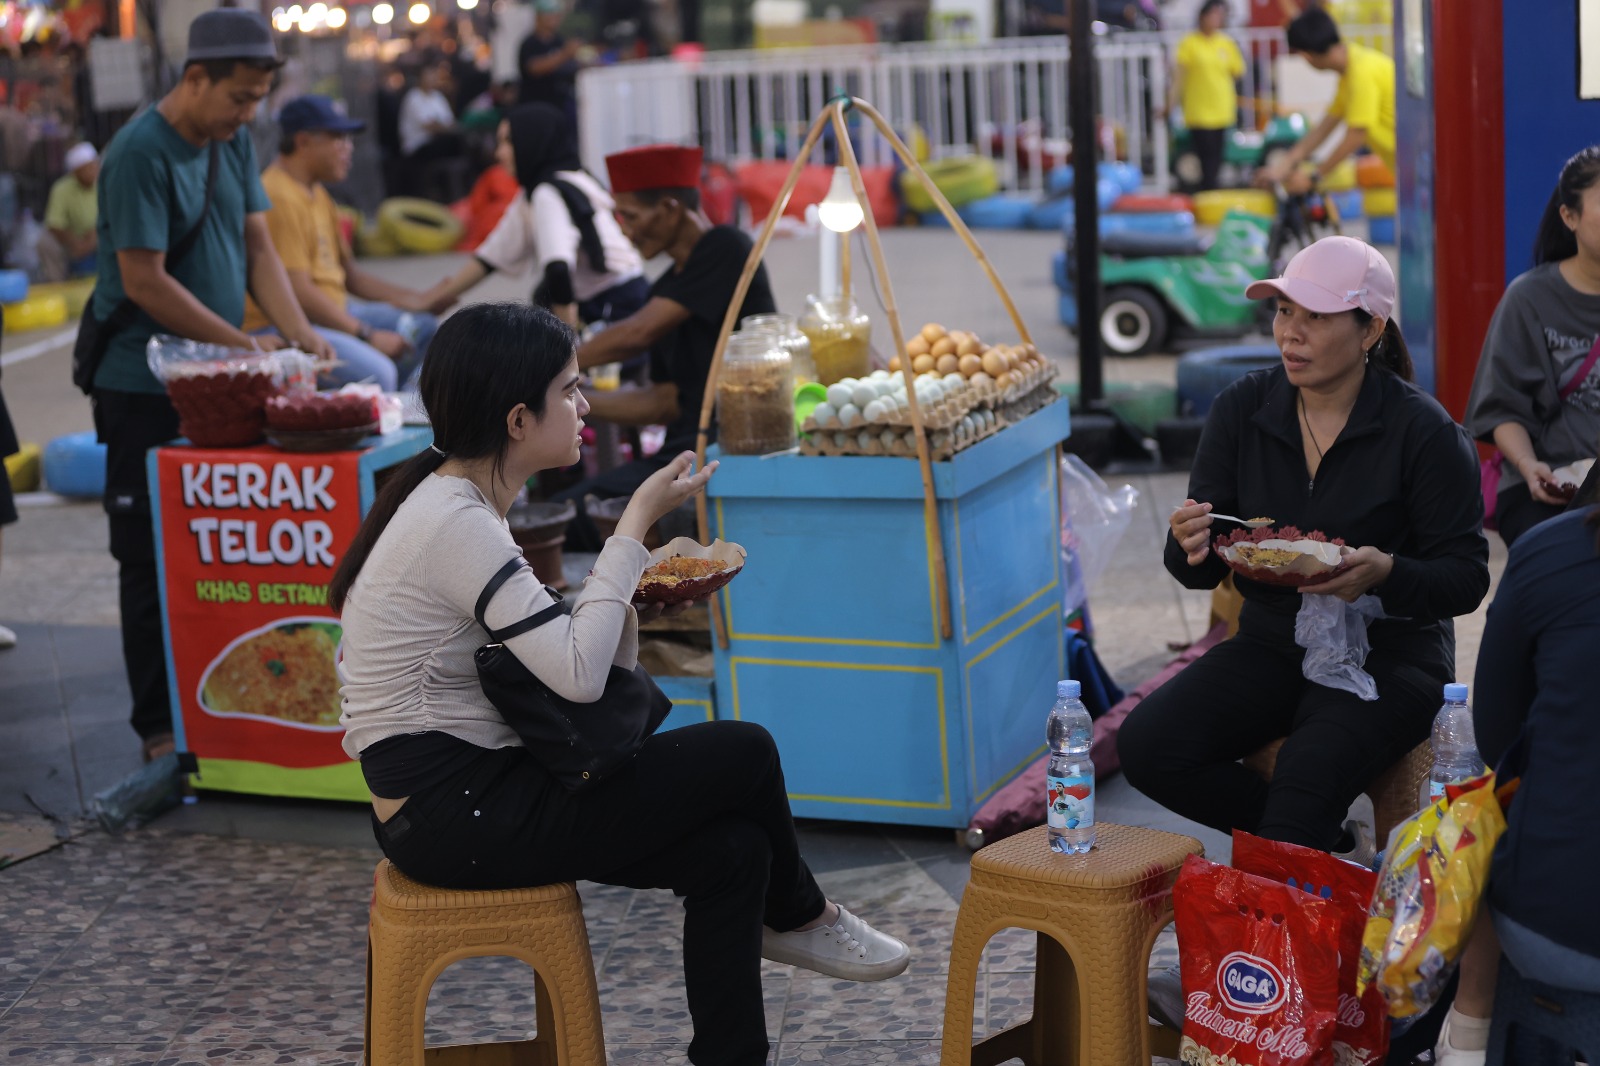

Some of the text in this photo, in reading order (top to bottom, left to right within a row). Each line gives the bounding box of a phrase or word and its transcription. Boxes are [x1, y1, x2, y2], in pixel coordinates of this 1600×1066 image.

[181, 462, 336, 511] KERAK
[190, 517, 335, 567] TELOR
[196, 580, 329, 606] KHAS BETAW
[1227, 968, 1270, 999] GAGA
[1185, 991, 1308, 1059] Indonesia Mie
